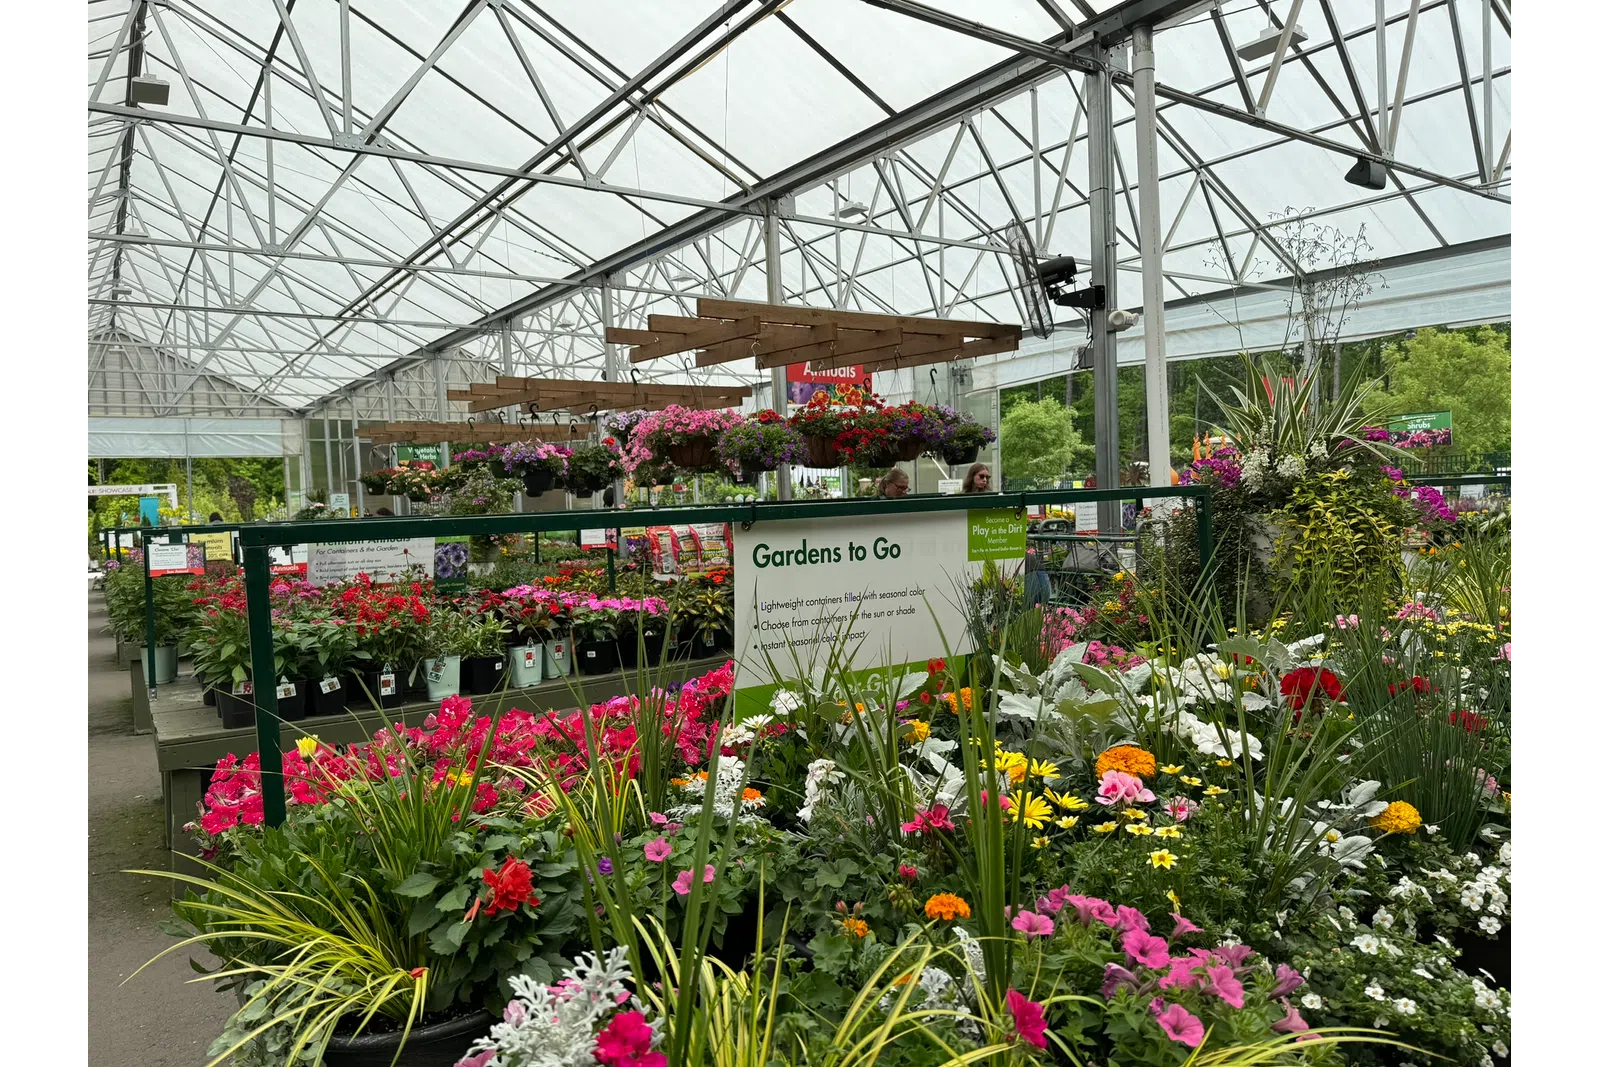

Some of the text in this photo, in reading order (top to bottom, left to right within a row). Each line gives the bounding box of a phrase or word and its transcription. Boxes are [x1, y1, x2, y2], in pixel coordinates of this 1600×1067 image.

[1407, 421, 1430, 429] Shrubs
[973, 524, 989, 538] Play
[998, 526, 1007, 534] the
[1008, 524, 1022, 533] Dirt
[988, 536, 1007, 544] Member
[752, 537, 901, 568] Gardens to Go
[760, 586, 925, 613] Lightweight containers filled with seasonal color
[761, 620, 789, 630] Choose
[792, 617, 808, 627] from
[850, 611, 859, 620] fr
[861, 610, 871, 619] the
[896, 605, 915, 615] shade
[761, 640, 786, 650] Instant
[788, 634, 819, 646] easonal
[821, 632, 838, 643] colo
